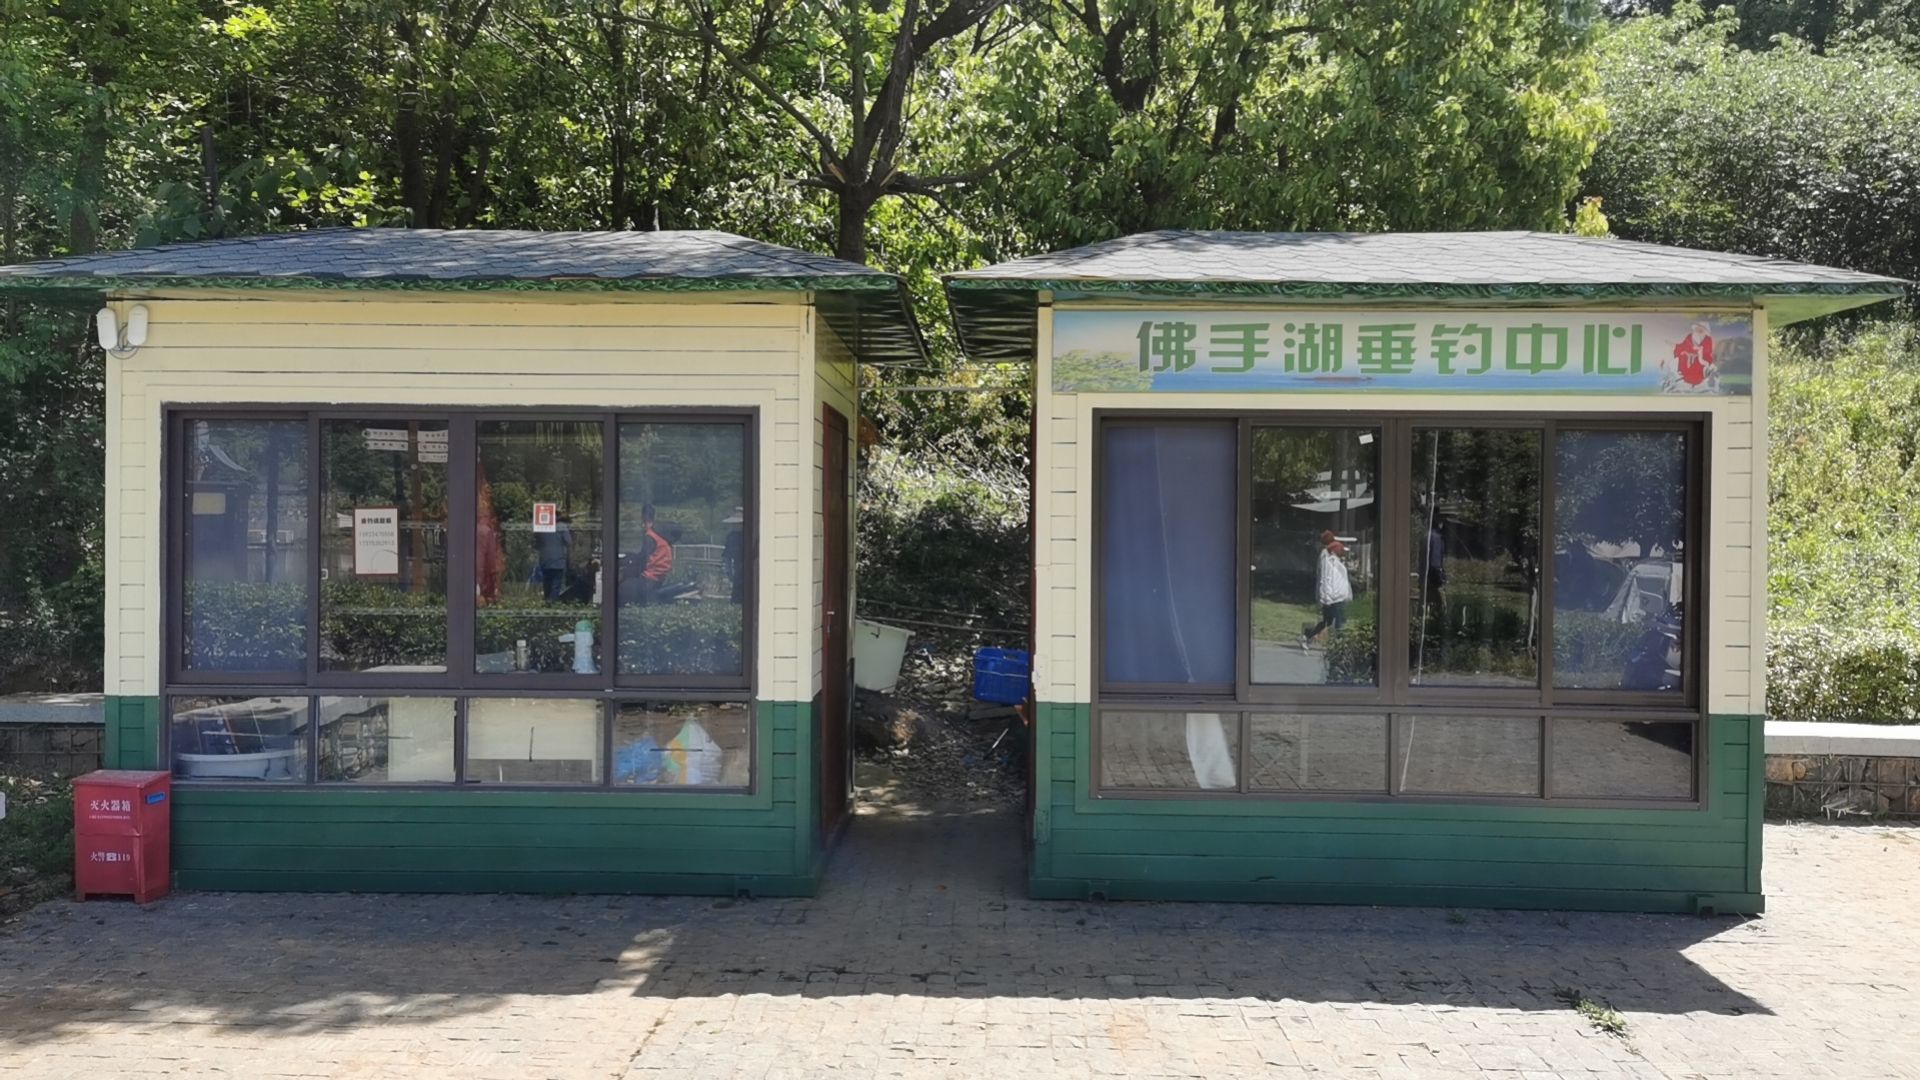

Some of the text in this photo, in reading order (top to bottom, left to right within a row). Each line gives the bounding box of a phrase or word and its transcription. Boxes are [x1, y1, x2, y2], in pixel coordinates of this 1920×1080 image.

[1136, 320, 1643, 376] 佛手湖垂钓中心
[90, 799, 131, 812] 灭火器箱
